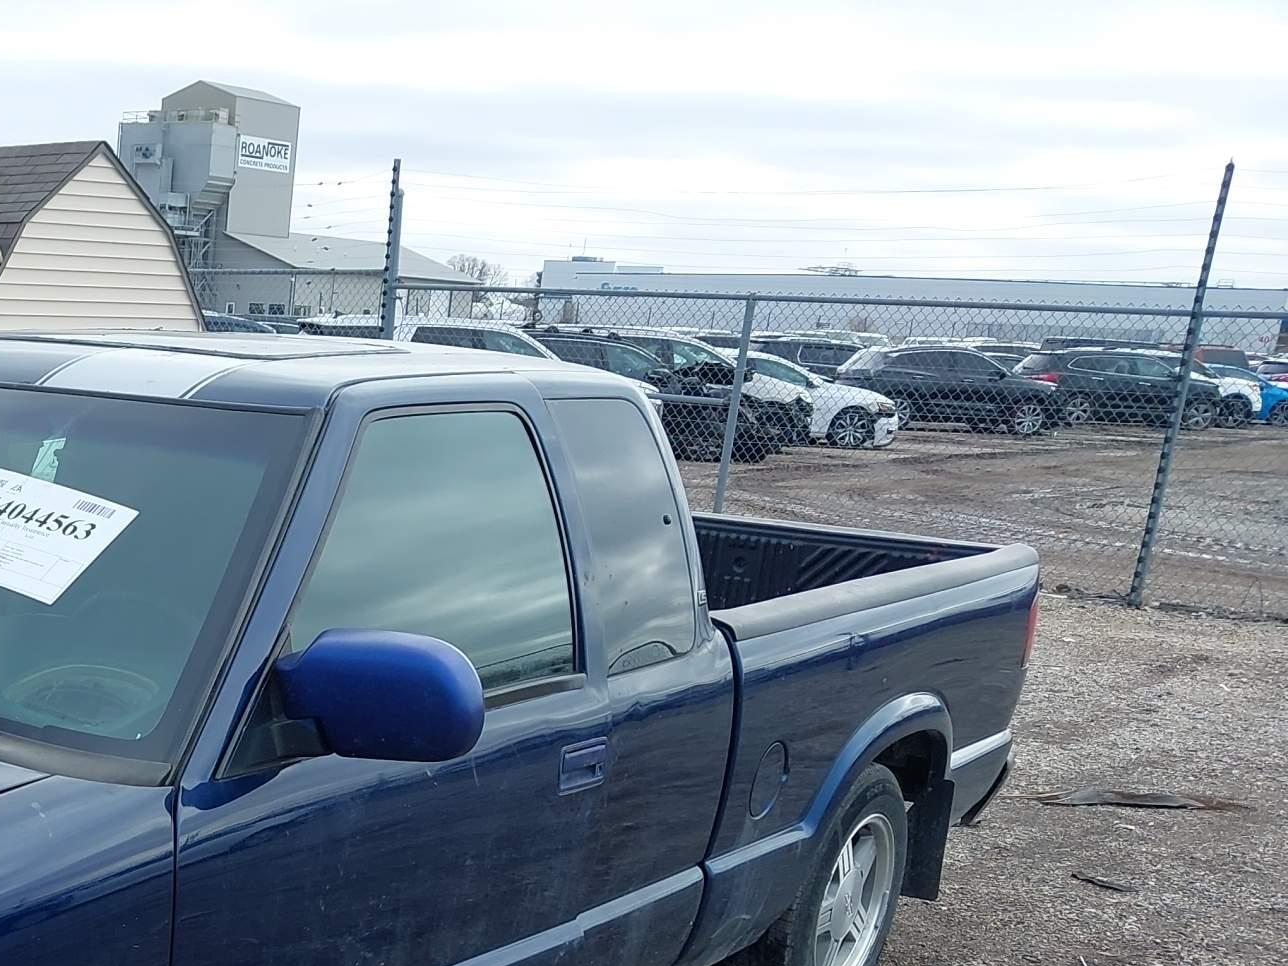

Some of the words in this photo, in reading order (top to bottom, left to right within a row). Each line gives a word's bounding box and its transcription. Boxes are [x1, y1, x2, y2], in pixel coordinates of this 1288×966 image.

[241, 141, 289, 160] ROANOKE
[239, 159, 264, 167] CONCRETE
[264, 162, 288, 171] PRODUCTS
